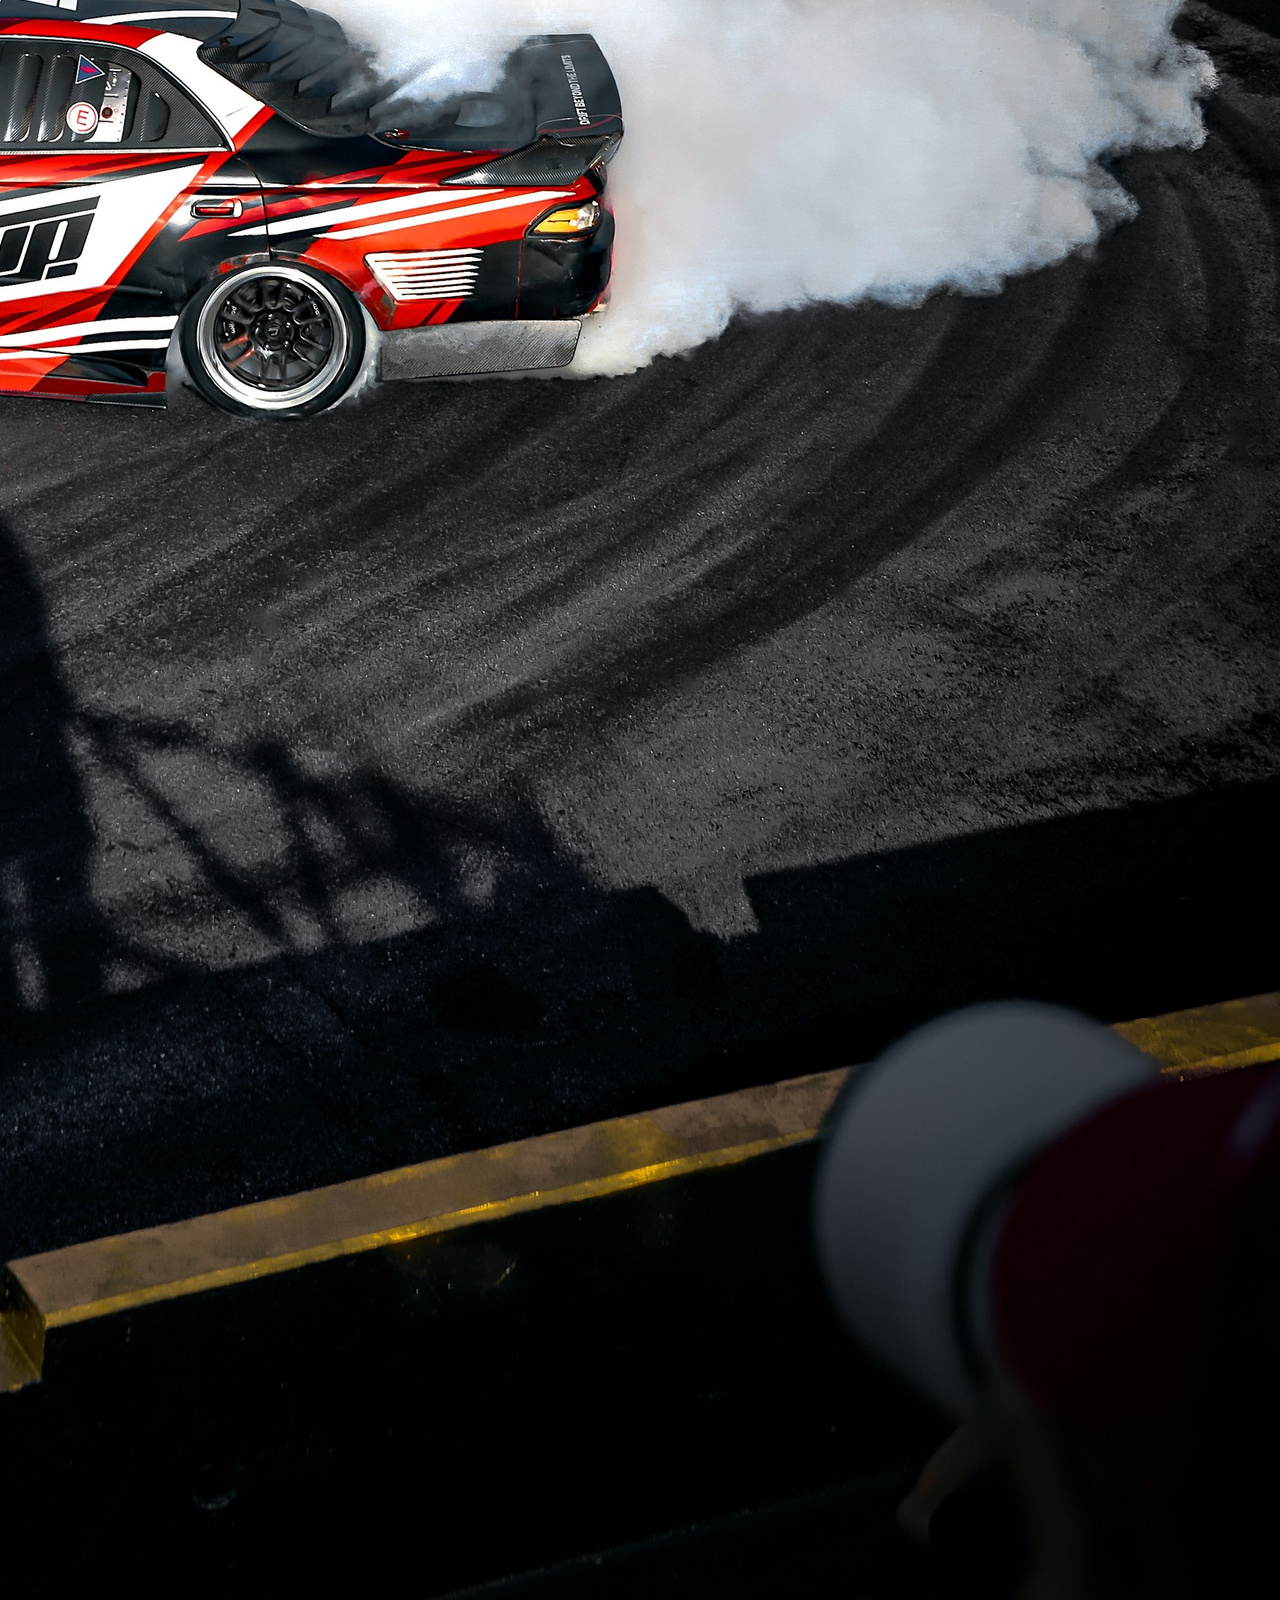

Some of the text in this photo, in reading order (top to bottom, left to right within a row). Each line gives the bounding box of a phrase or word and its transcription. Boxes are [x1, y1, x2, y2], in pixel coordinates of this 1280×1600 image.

[560, 54, 576, 73] LIMITS
[569, 83, 586, 107] BEYOND
[576, 106, 591, 126] DRIFT
